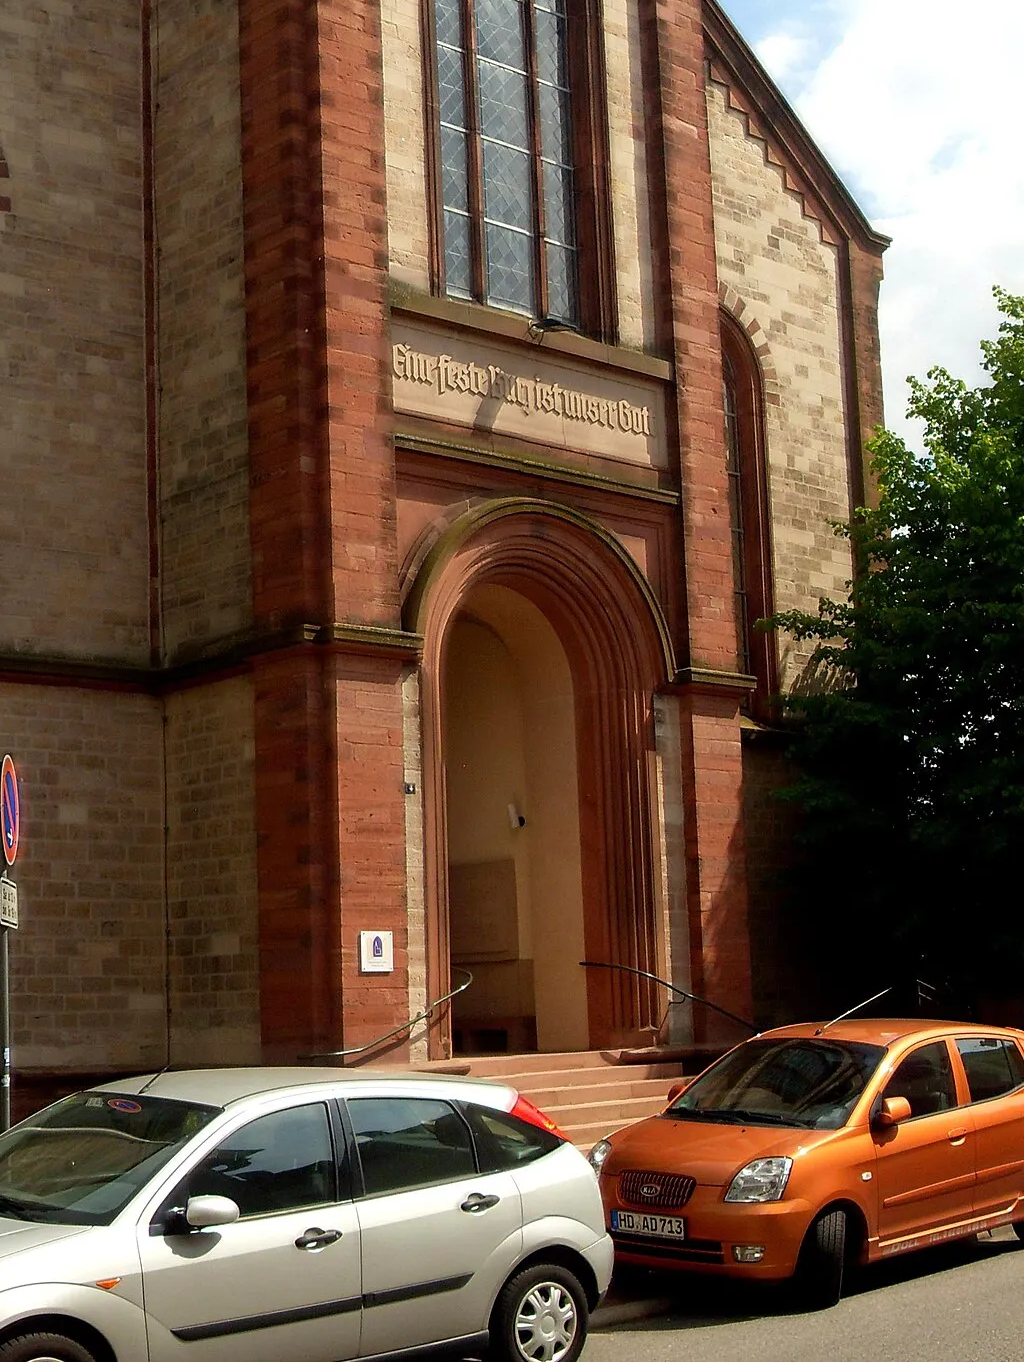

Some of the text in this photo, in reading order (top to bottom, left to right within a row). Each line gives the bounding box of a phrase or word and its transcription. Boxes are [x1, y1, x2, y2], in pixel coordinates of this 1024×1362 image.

[392, 342, 438, 384] Eine
[438, 354, 488, 395] feste
[535, 377, 563, 415] ist
[562, 390, 618, 428] unser
[643, 1186, 656, 1194] KIA
[618, 1213, 635, 1229] HD
